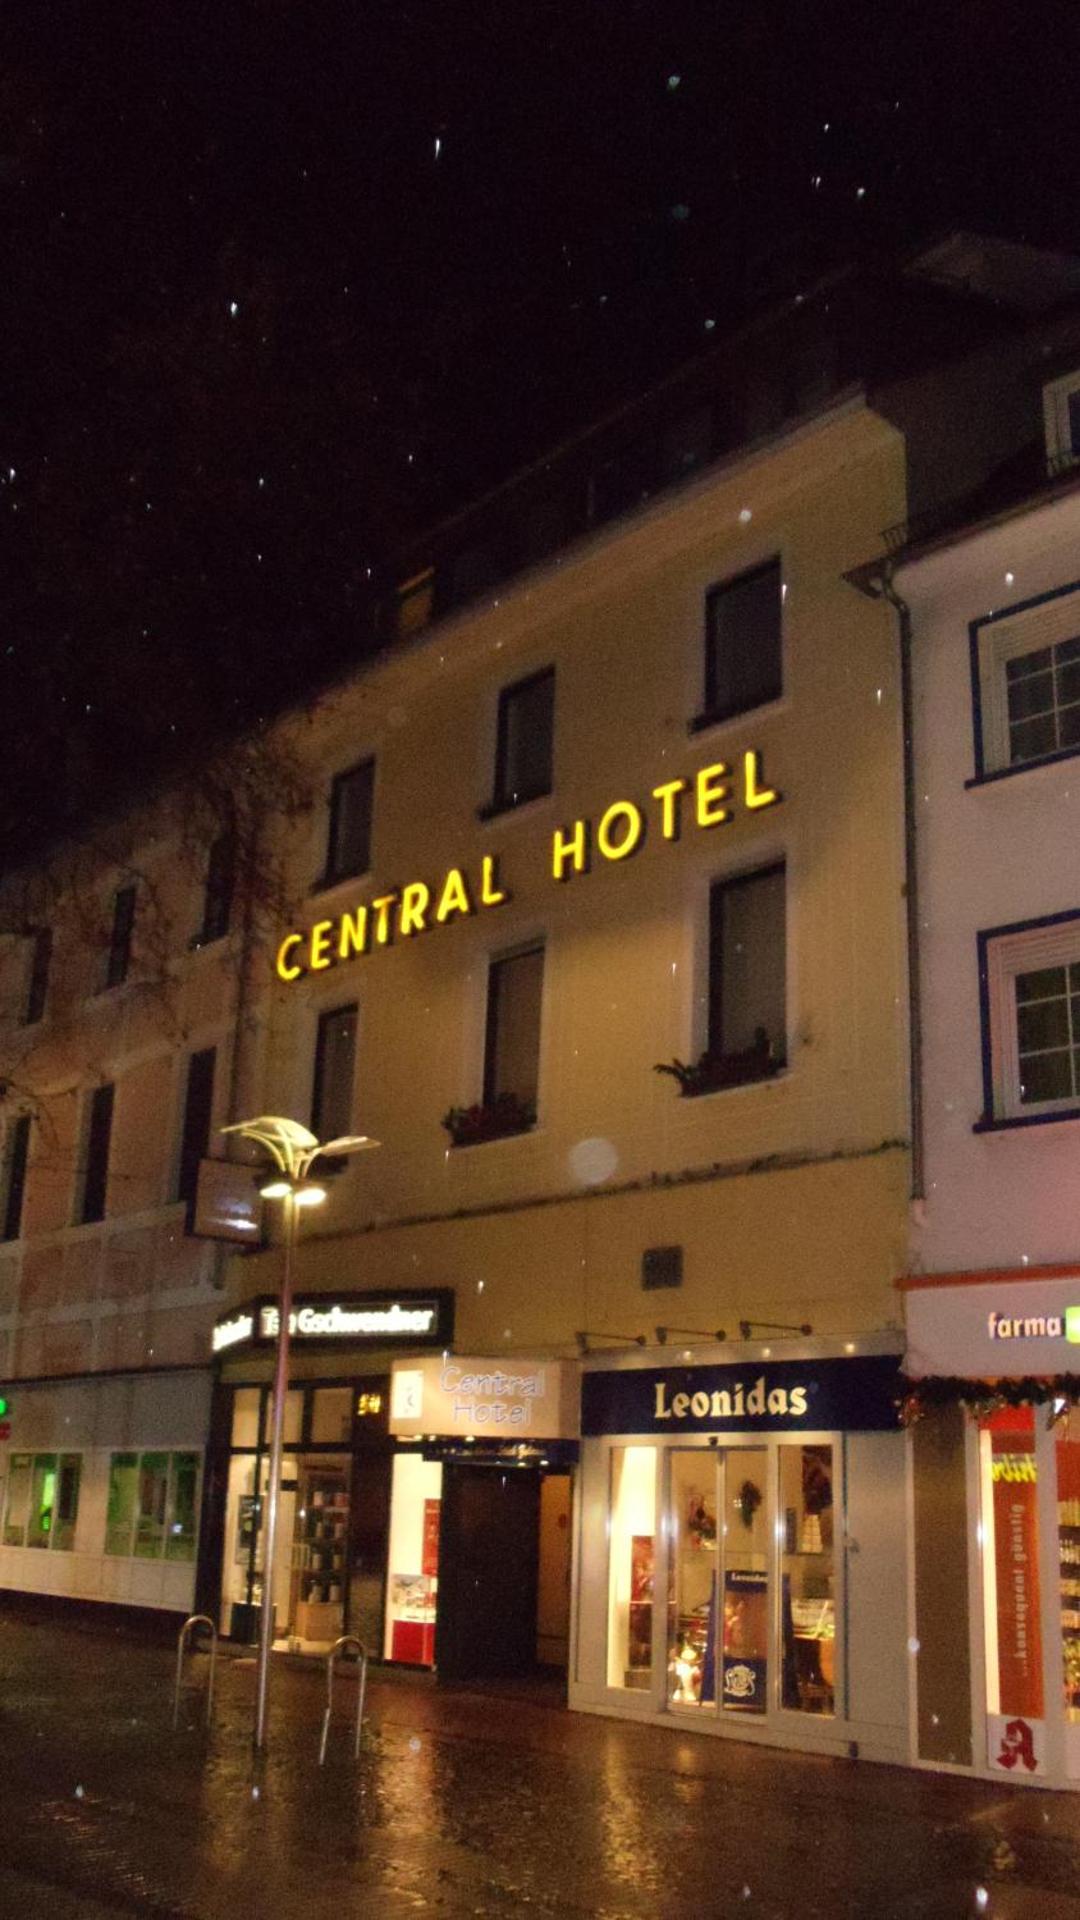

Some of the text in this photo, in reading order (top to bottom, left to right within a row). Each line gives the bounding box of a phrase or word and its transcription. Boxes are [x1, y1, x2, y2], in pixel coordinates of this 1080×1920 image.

[276, 751, 776, 981] CENTRAL HOTEL
[988, 1311, 1062, 1340] farma
[440, 1366, 545, 1397] Central
[653, 1376, 808, 1418] Leonidas
[453, 1397, 533, 1425] Hotel
